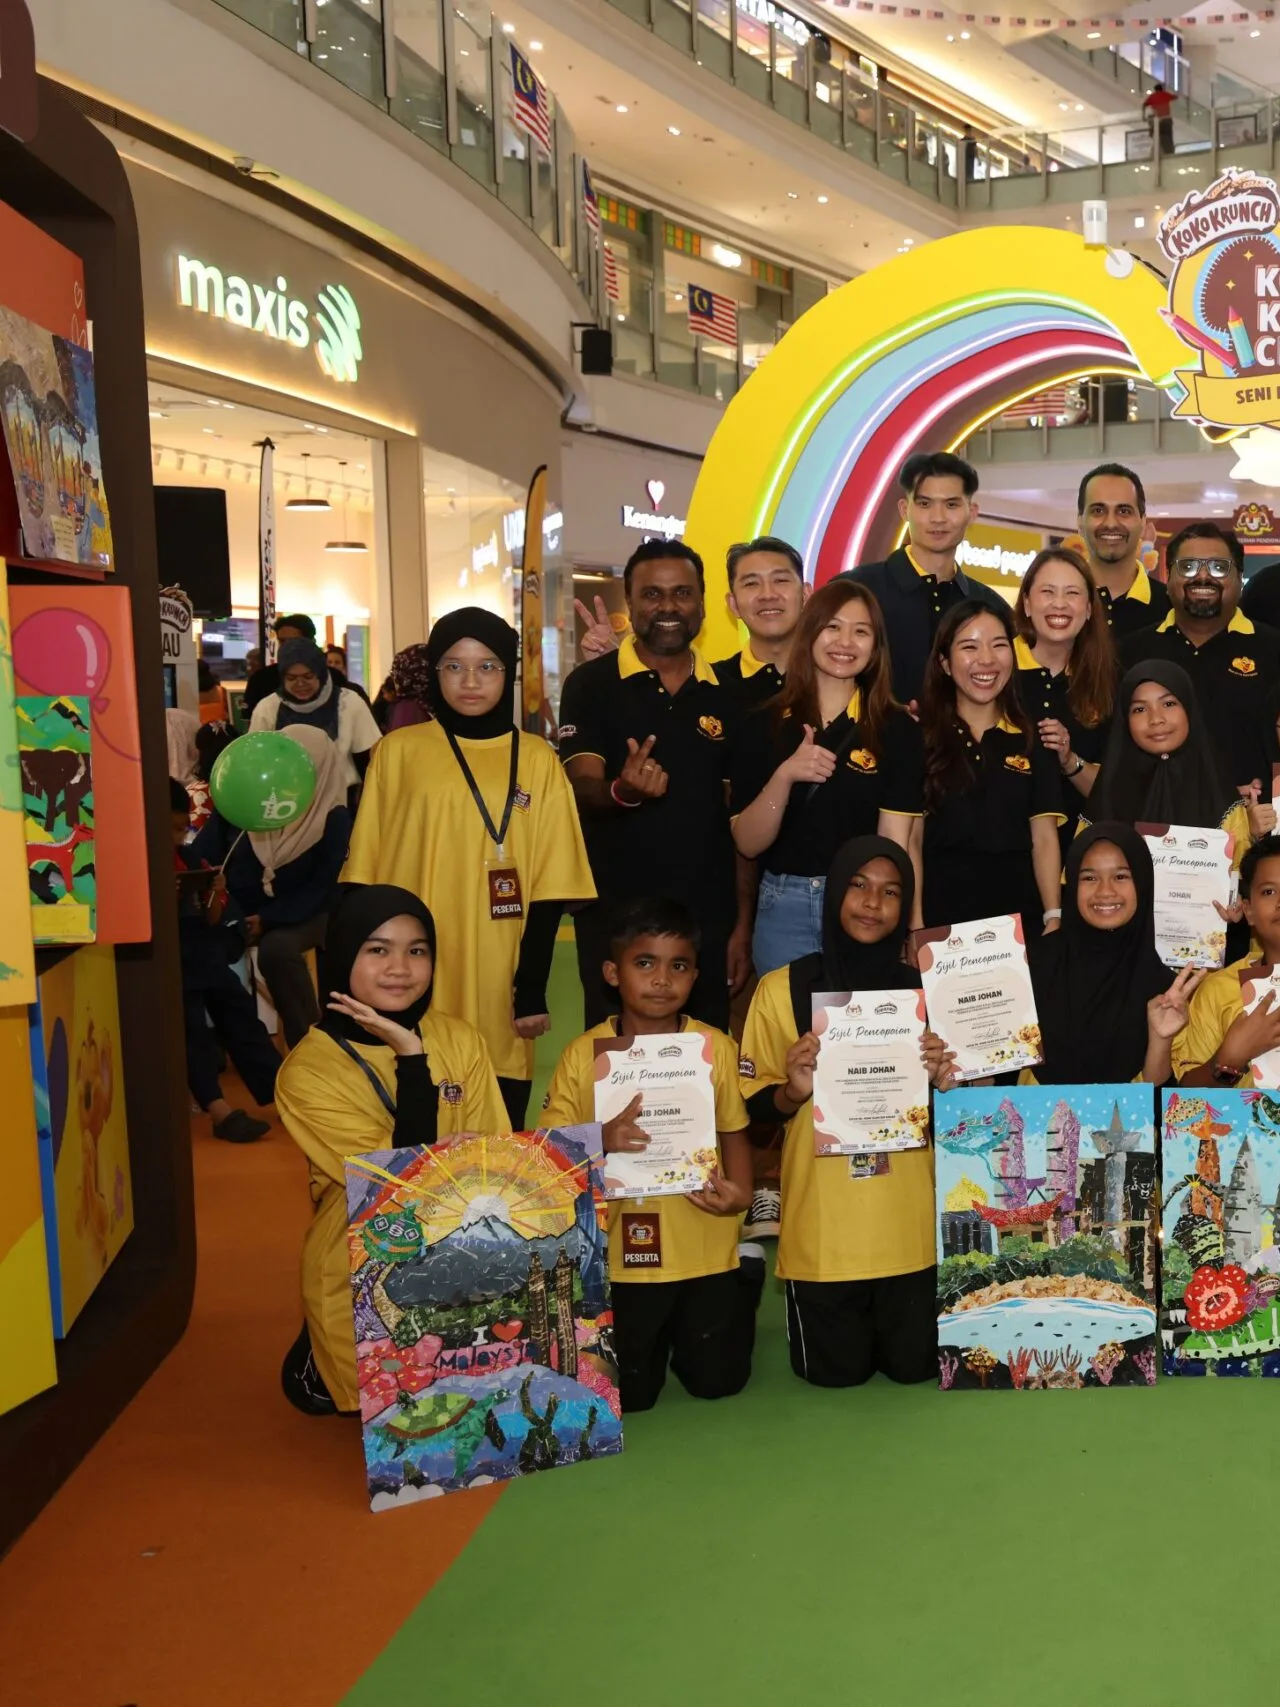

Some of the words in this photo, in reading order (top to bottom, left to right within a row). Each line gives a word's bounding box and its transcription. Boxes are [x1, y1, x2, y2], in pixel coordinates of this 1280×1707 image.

[177, 254, 310, 348] maxis
[1235, 386, 1272, 405] SENI
[1151, 854, 1166, 867] ijil
[1168, 891, 1192, 899] JOHAN
[492, 903, 522, 914] PESERTA
[958, 994, 977, 1005] NAIB
[977, 990, 1003, 1001] JOHAN
[847, 1067, 868, 1075] NAIB
[869, 1065, 896, 1074] JOHAN
[638, 1110, 652, 1118] AIB
[653, 1108, 681, 1116] JOHAN
[624, 1253, 660, 1263] PESERTA
[471, 1325, 489, 1346] I
